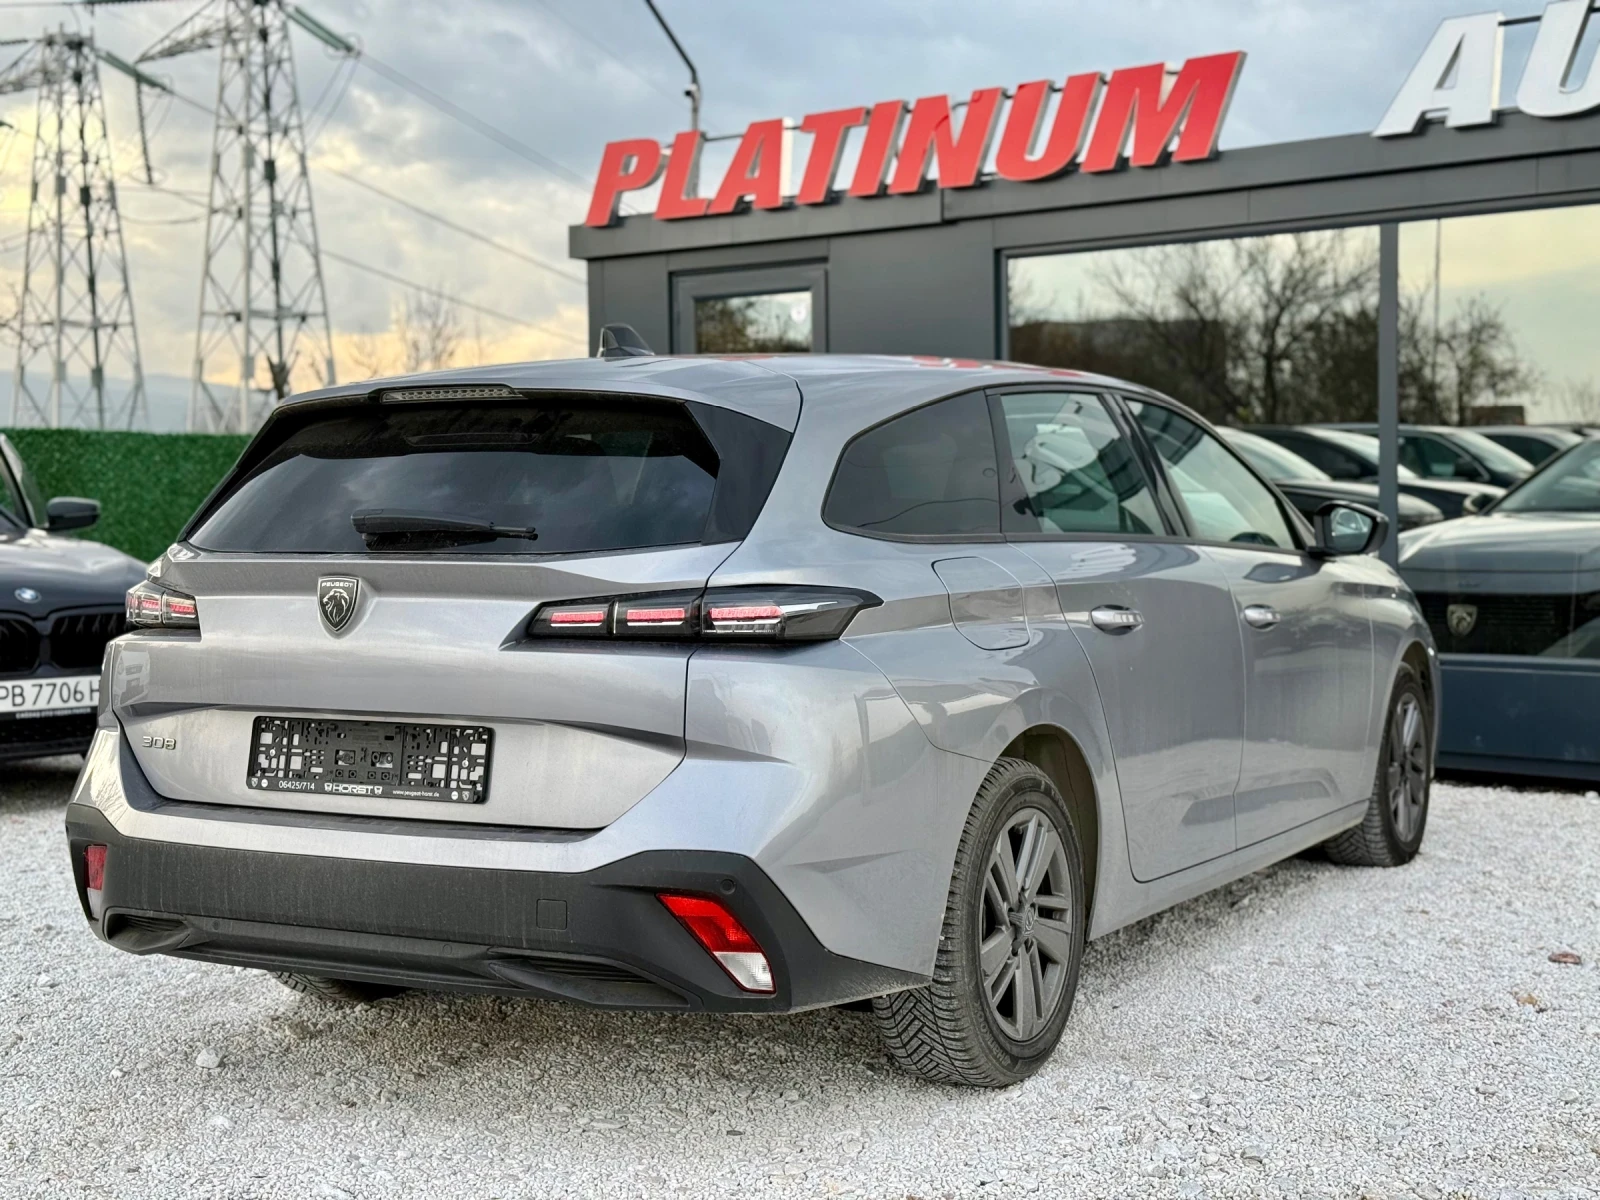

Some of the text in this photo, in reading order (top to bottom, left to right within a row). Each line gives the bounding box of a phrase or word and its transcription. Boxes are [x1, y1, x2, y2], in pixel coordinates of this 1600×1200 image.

[584, 0, 1600, 228] PLATINUM AU
[31, 681, 85, 704] 7706
[141, 735, 177, 750] 308
[278, 780, 315, 790] 06425/714
[332, 783, 373, 794] HORST
